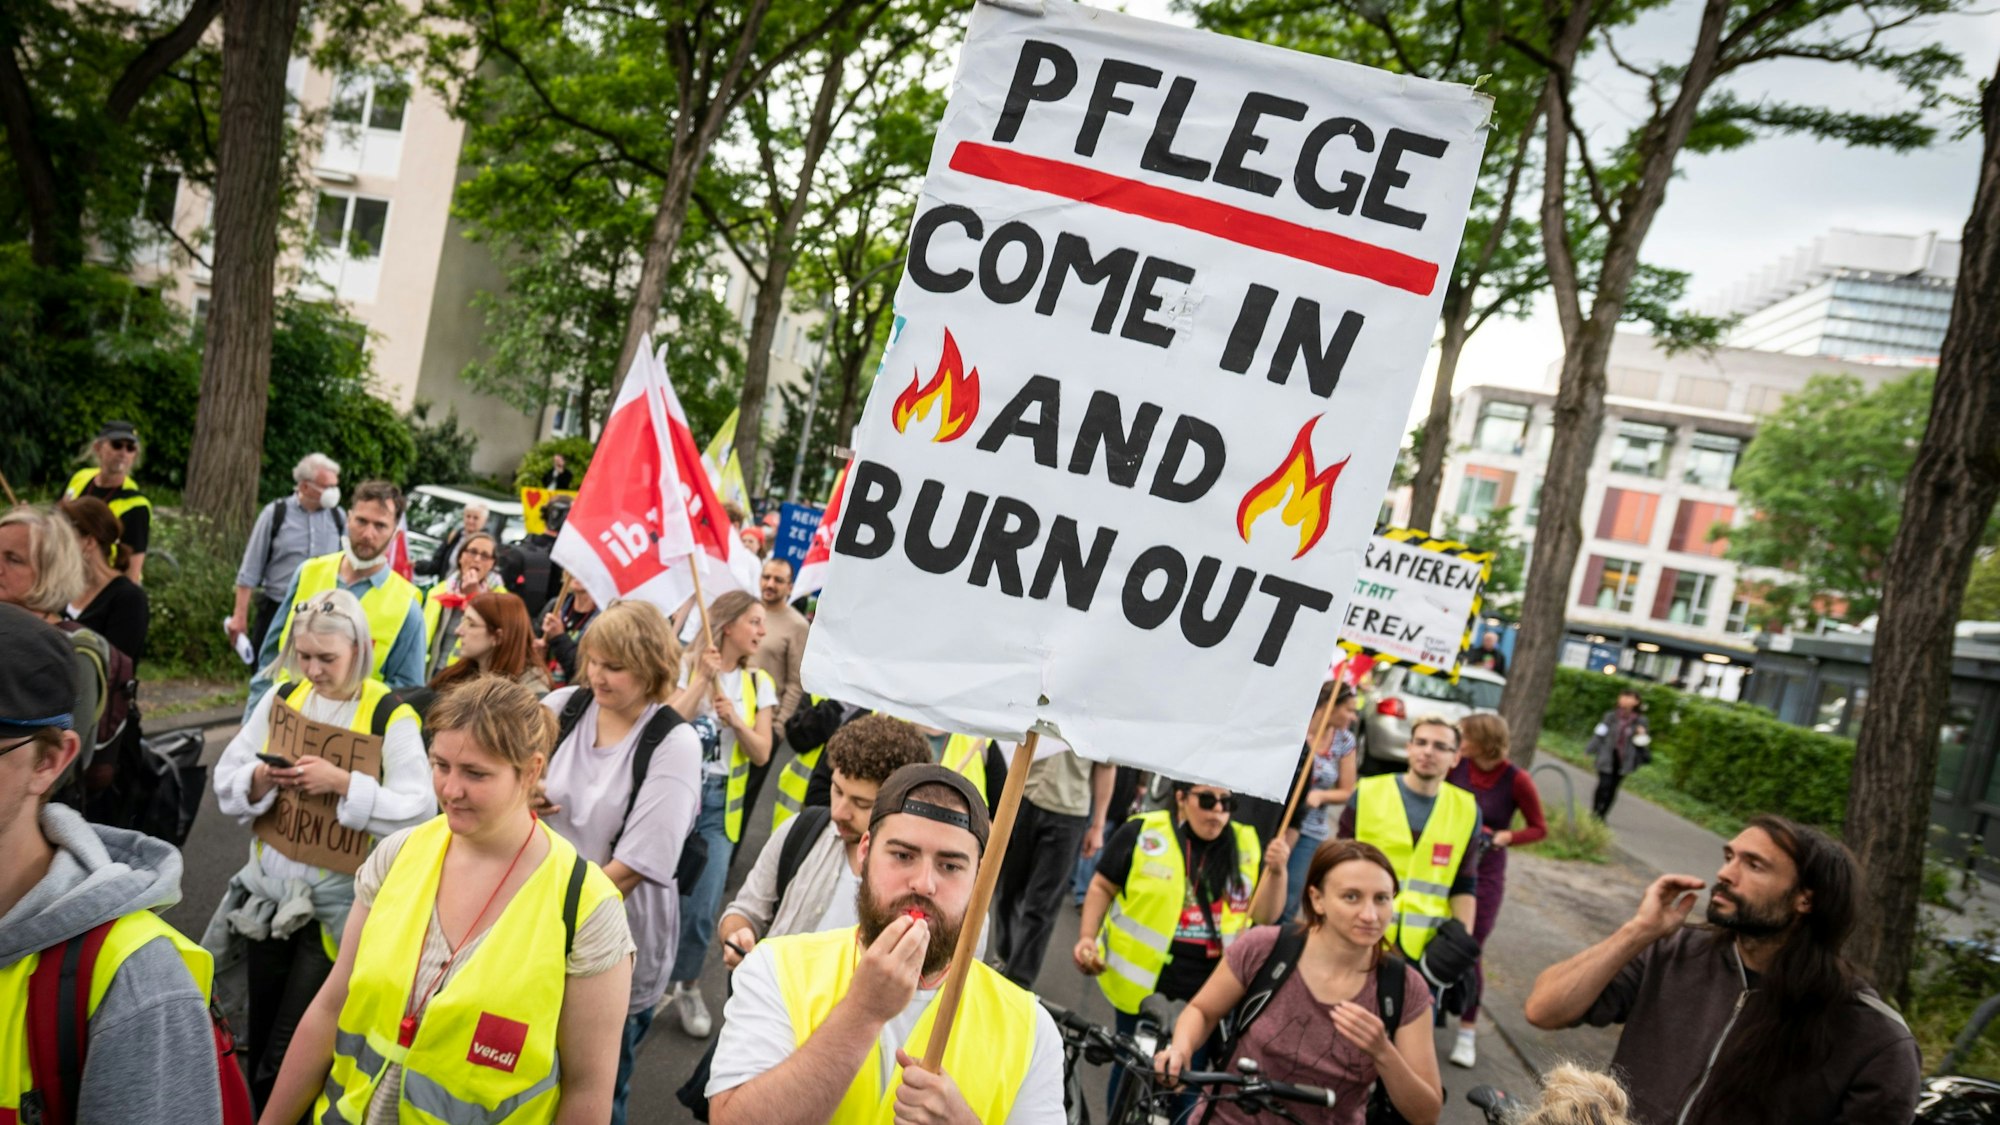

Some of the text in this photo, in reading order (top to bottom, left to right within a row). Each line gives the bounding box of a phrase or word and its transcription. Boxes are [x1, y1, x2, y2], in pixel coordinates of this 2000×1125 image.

[992, 39, 1450, 231] PFLEGE
[907, 203, 1365, 399] COME IN
[976, 375, 1227, 504] AND
[834, 460, 1334, 667] BURN OUT
[1354, 579, 1398, 600] TATT
[273, 705, 369, 773] PFLEGE
[276, 798, 324, 846] BURN
[474, 1042, 516, 1066] ver.di
